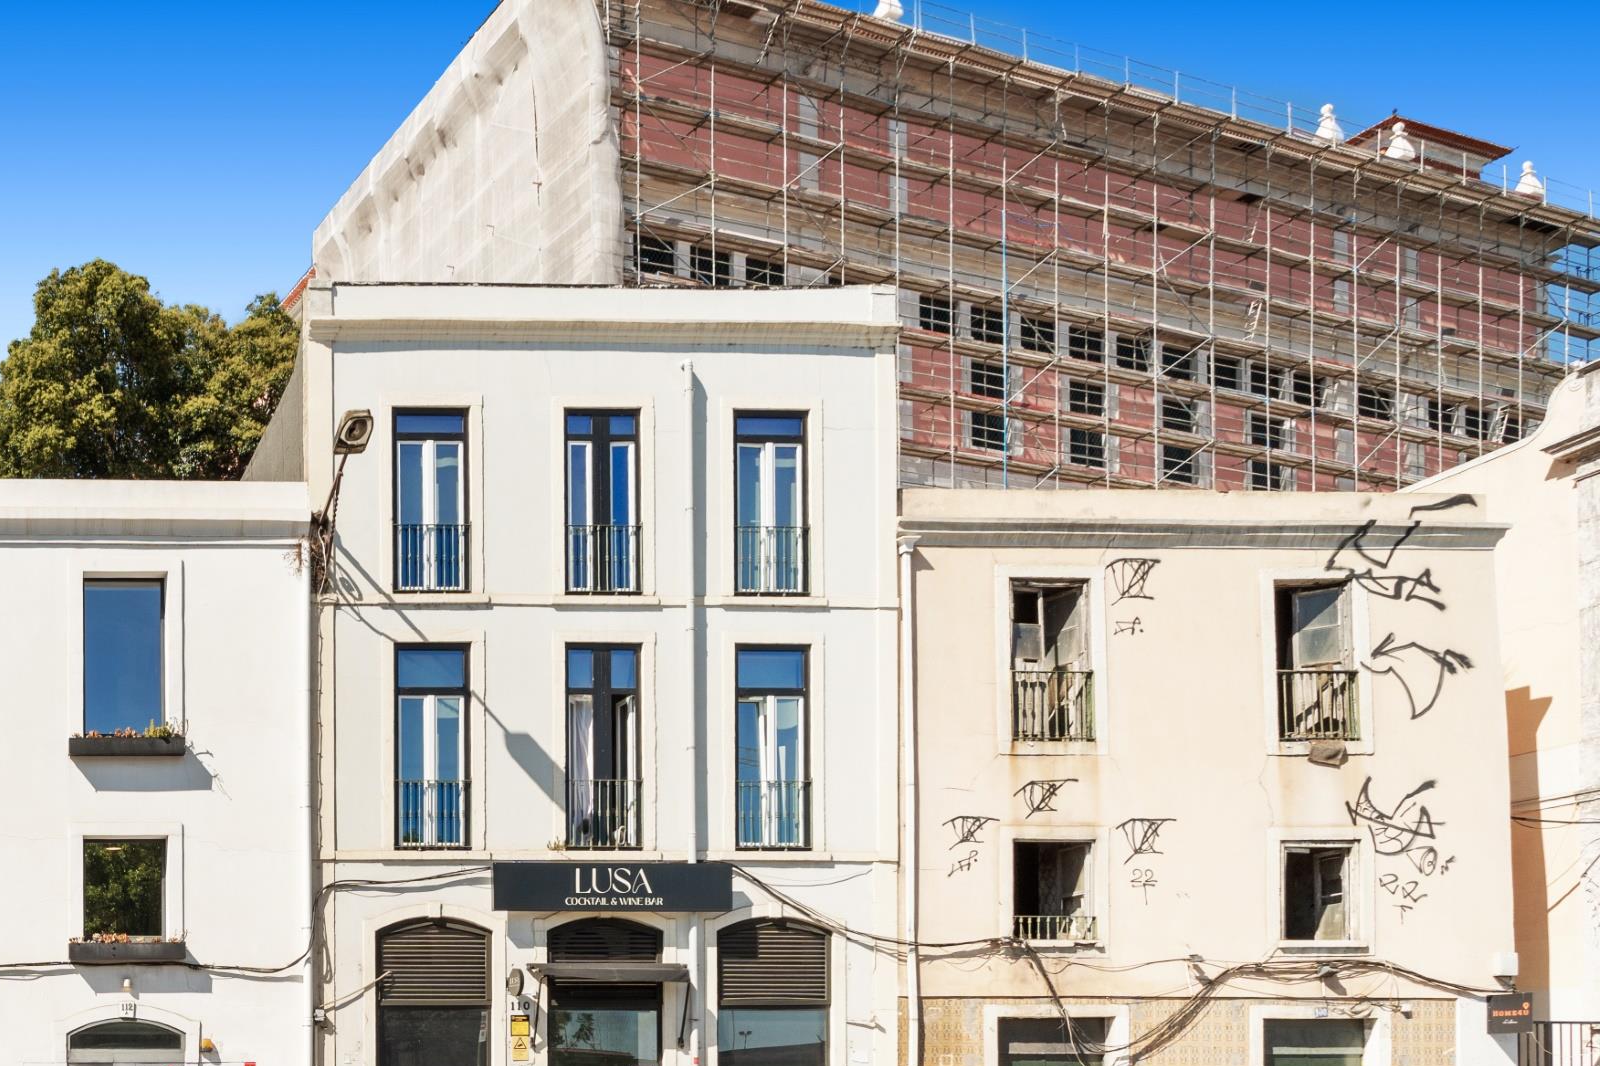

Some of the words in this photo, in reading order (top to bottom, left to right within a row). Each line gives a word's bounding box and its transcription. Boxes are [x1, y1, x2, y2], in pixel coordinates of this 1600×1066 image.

[575, 867, 653, 894] LUSA
[564, 897, 609, 906] COCKTAIL
[610, 897, 618, 906] &
[619, 897, 643, 906] WINE
[644, 897, 664, 906] BAR
[121, 1003, 134, 1011] 112
[511, 1001, 530, 1011] 110
